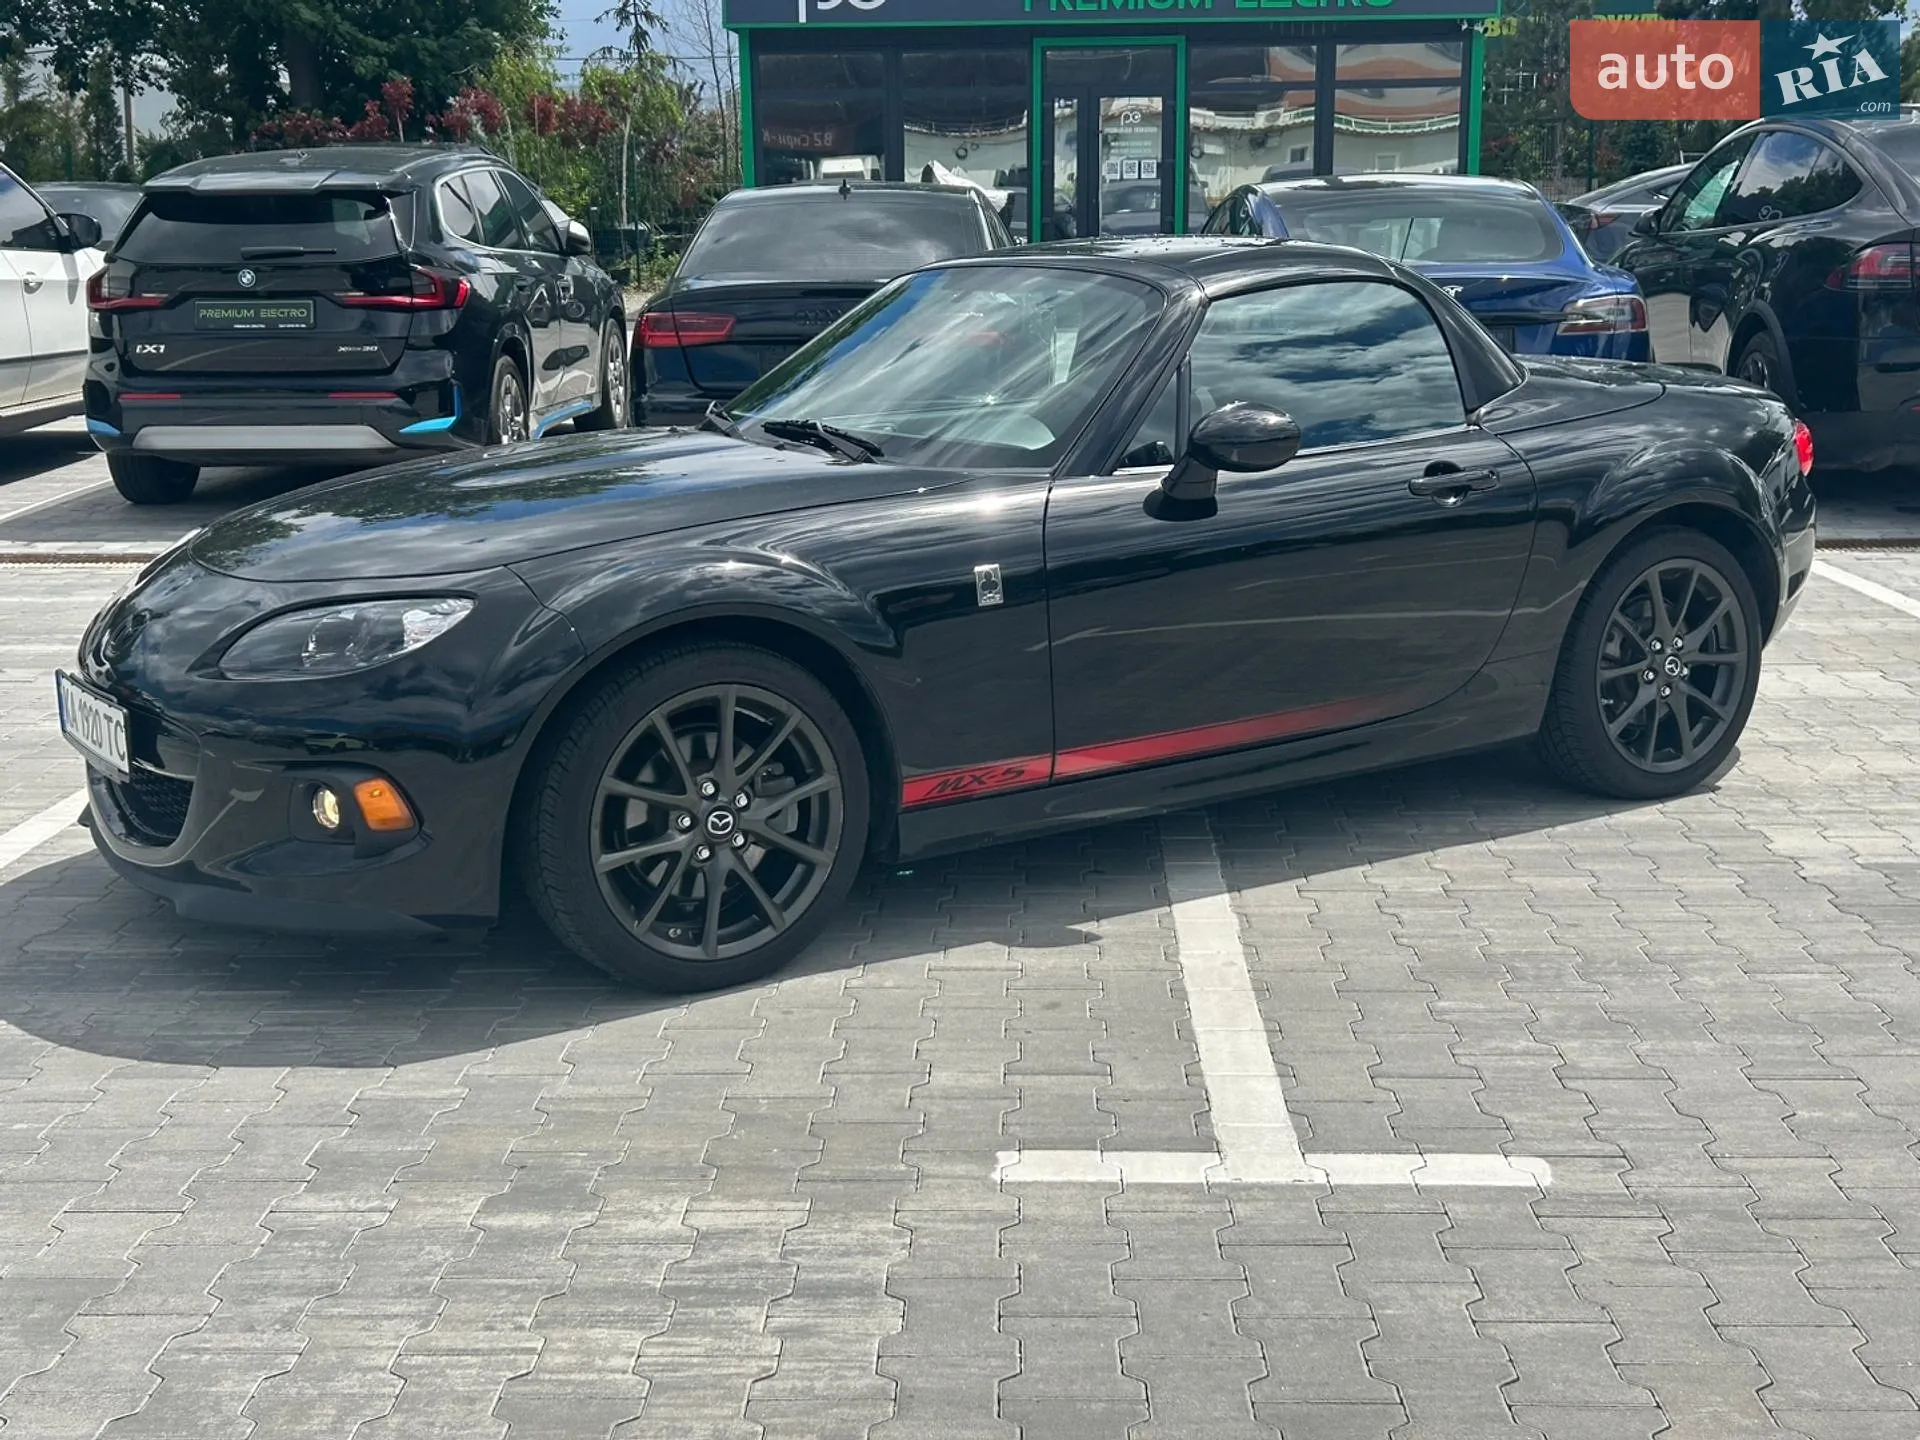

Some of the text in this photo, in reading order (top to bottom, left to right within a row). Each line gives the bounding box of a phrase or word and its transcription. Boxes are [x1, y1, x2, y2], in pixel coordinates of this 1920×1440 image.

[200, 307, 308, 319] PREMIUM ELECTRO
[103, 713, 125, 761] TC
